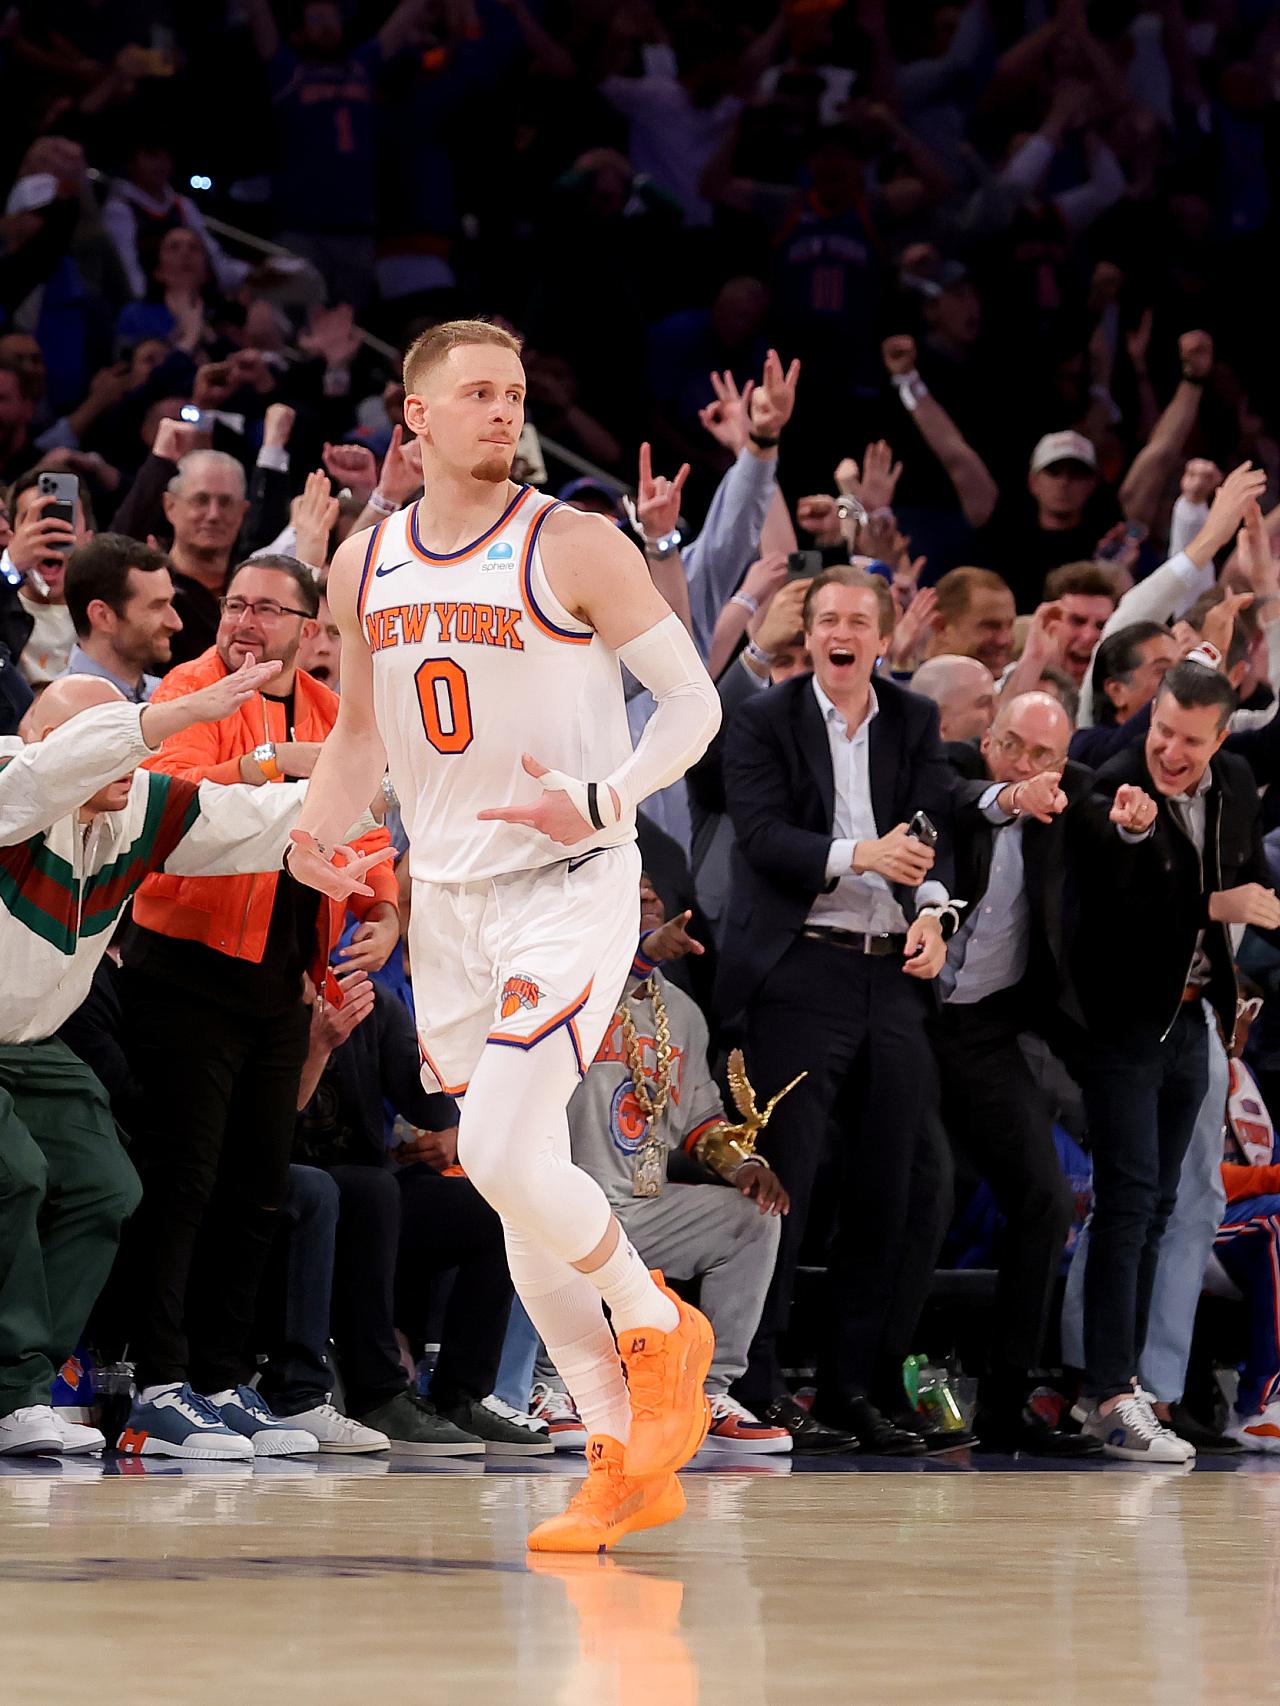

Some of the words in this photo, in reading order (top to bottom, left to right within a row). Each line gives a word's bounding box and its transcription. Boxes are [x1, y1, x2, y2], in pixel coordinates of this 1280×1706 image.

[481, 560, 515, 572] sphere
[365, 603, 430, 654] NEW
[434, 602, 524, 652] YORK
[413, 656, 474, 755] 0
